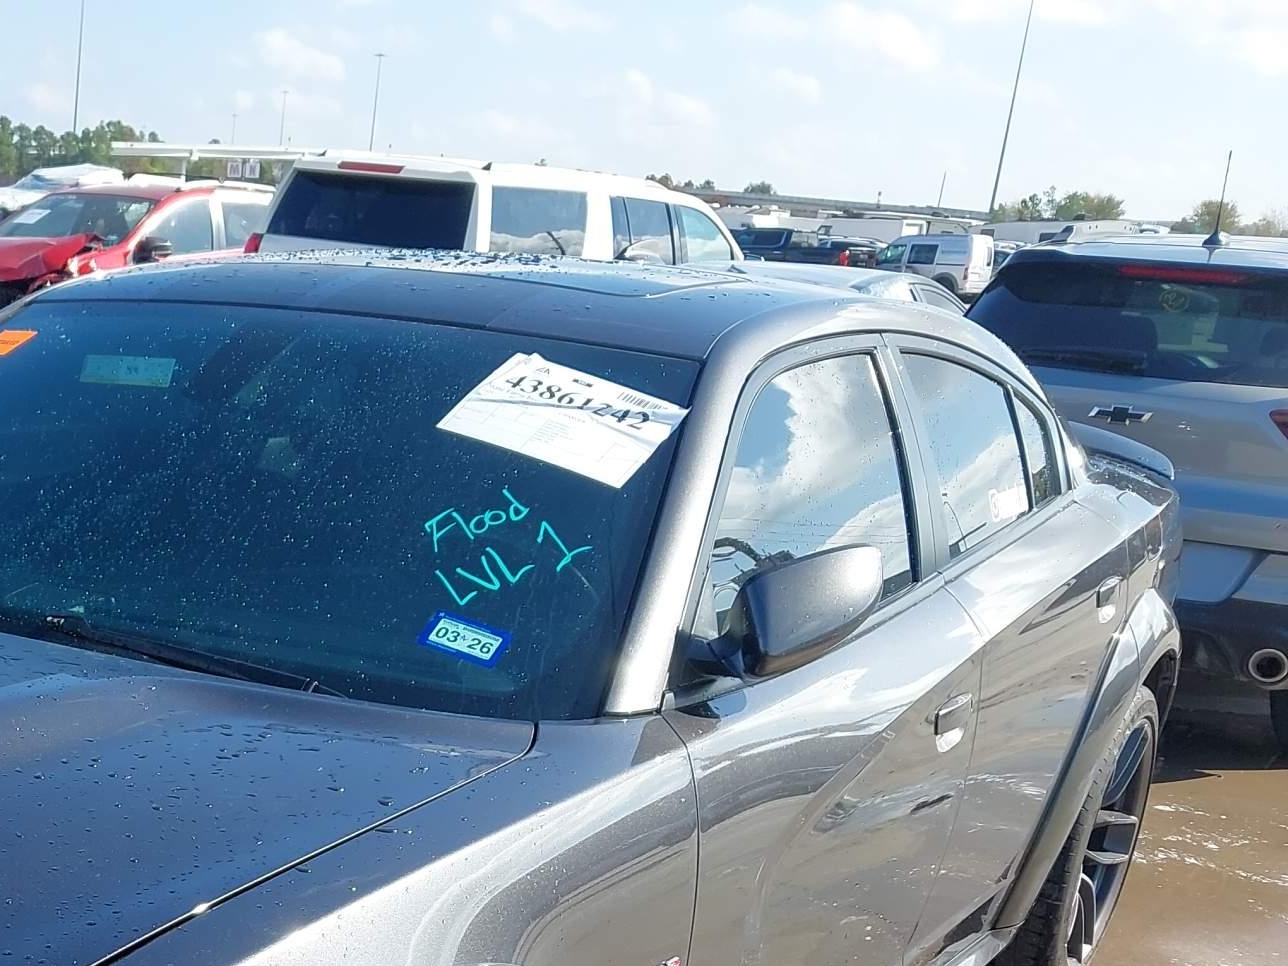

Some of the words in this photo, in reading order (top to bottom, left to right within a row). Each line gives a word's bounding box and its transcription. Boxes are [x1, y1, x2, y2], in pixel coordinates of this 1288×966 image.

[505, 375, 650, 430] 43861242
[424, 488, 530, 553] Flood
[434, 546, 536, 606] LVL
[435, 626, 461, 643] 03
[466, 637, 494, 655] 26
